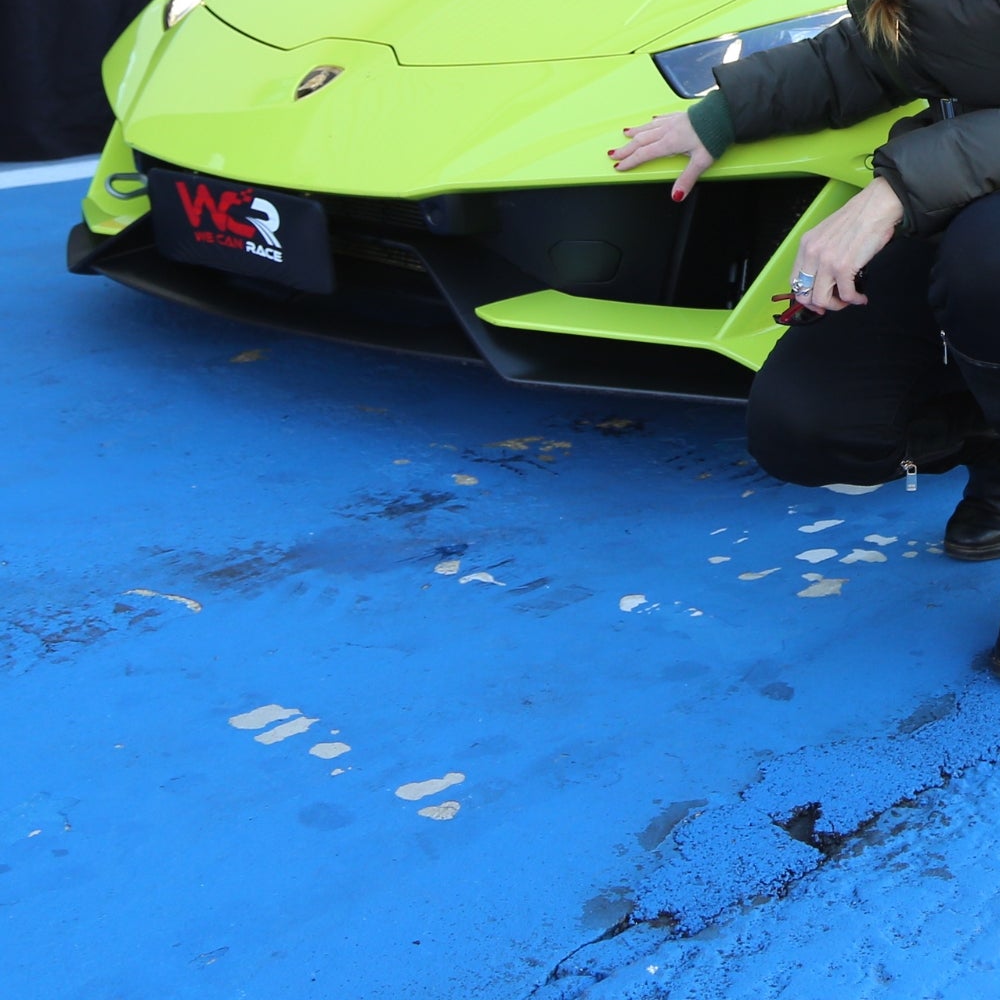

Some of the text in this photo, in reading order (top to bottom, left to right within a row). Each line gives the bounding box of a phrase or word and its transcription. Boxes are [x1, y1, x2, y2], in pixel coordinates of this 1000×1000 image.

[194, 231, 283, 263] WE CAN RACE
